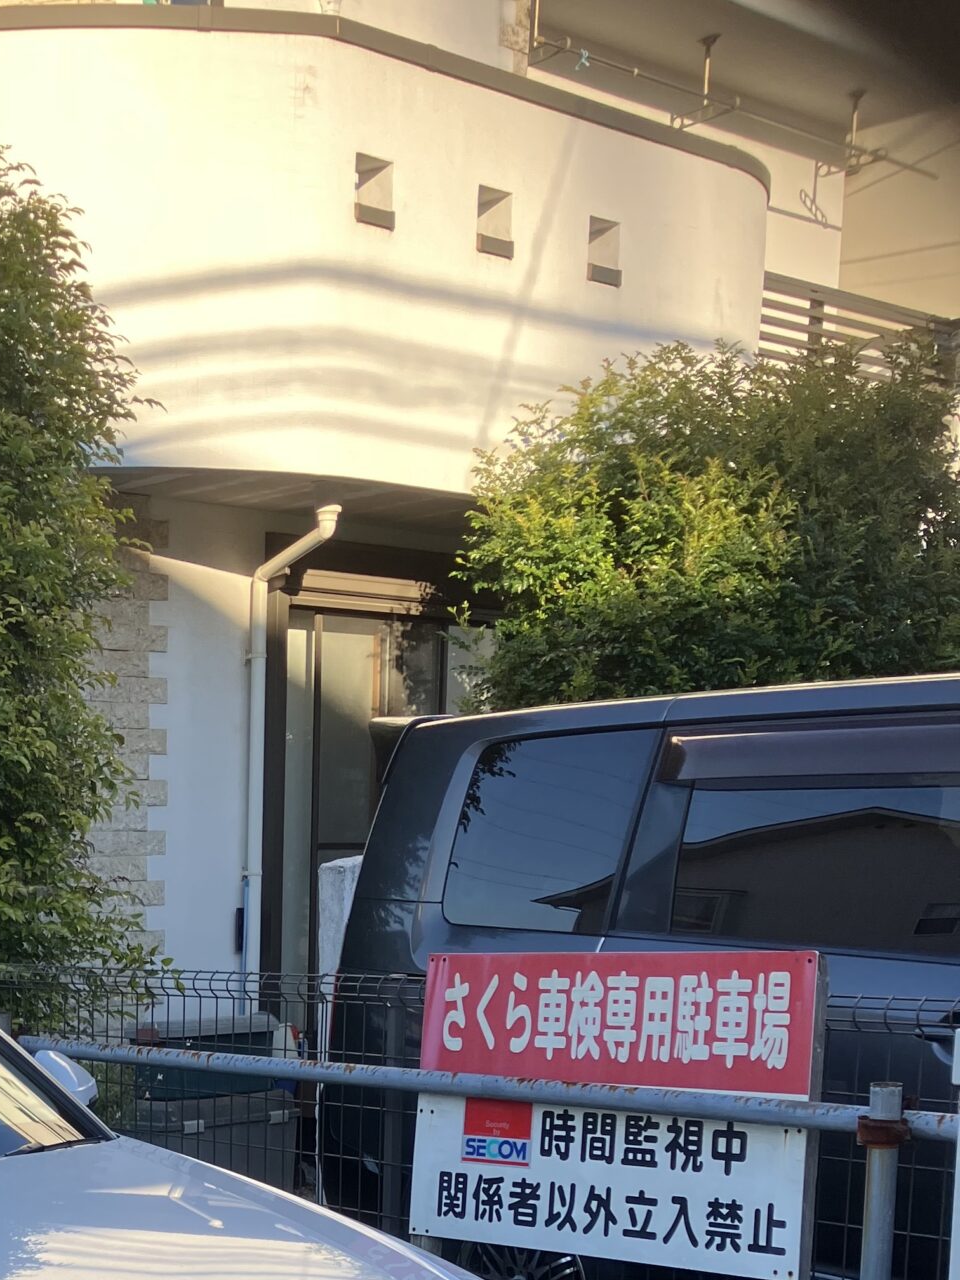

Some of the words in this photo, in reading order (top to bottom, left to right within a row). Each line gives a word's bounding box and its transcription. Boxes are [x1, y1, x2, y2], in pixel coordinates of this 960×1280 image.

[442, 969, 791, 1070] さくら車検専用駐車場
[465, 1137, 527, 1160] SECOM
[540, 1109, 748, 1176] 時間監視中
[437, 1171, 787, 1256] 関係者以外立入禁止
